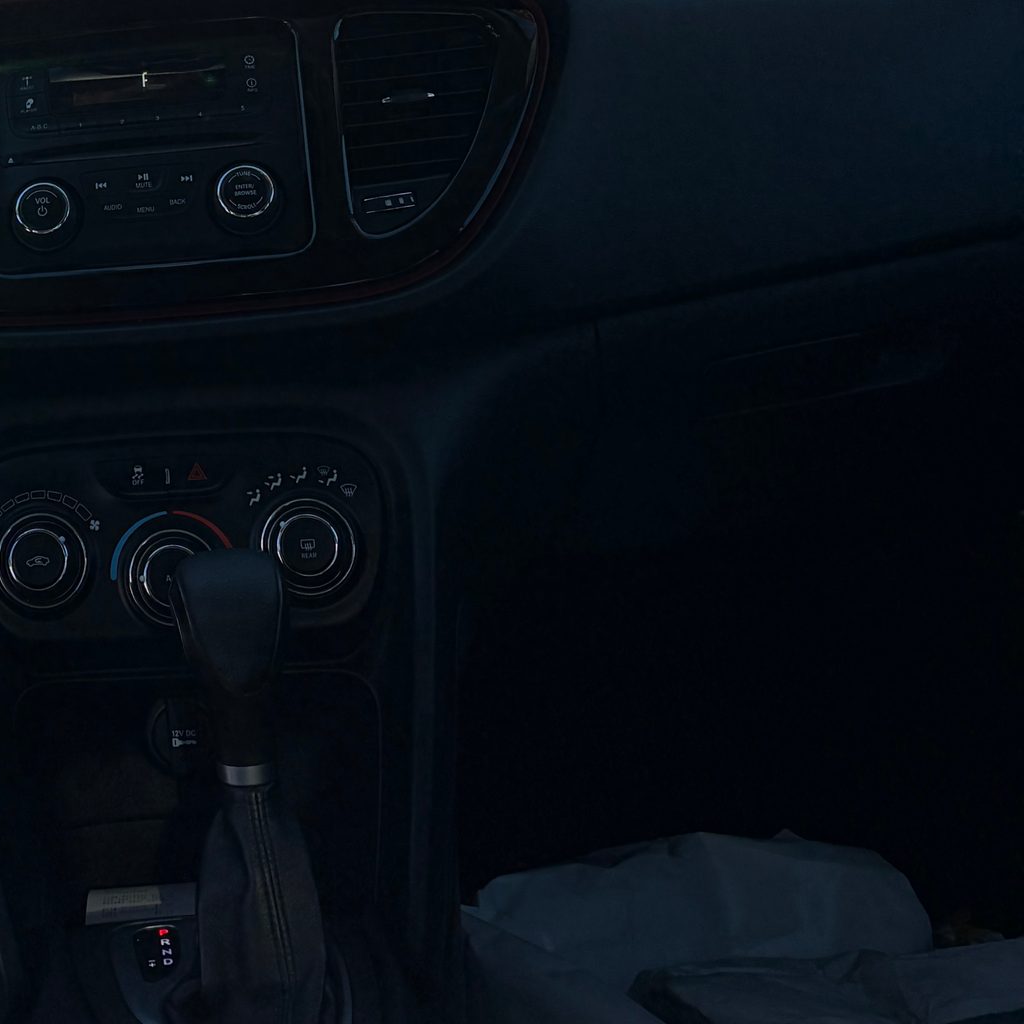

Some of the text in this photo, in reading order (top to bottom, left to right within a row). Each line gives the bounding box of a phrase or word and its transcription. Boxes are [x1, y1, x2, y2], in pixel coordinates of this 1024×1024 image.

[135, 181, 153, 189] MUTE
[35, 197, 51, 205] VOL
[169, 198, 186, 206] BACK
[103, 203, 123, 212] AUDIO
[136, 206, 155, 214] MENU
[131, 476, 145, 485] OFF
[160, 937, 172, 946] R
[162, 947, 173, 956] N
[163, 957, 174, 966] D
